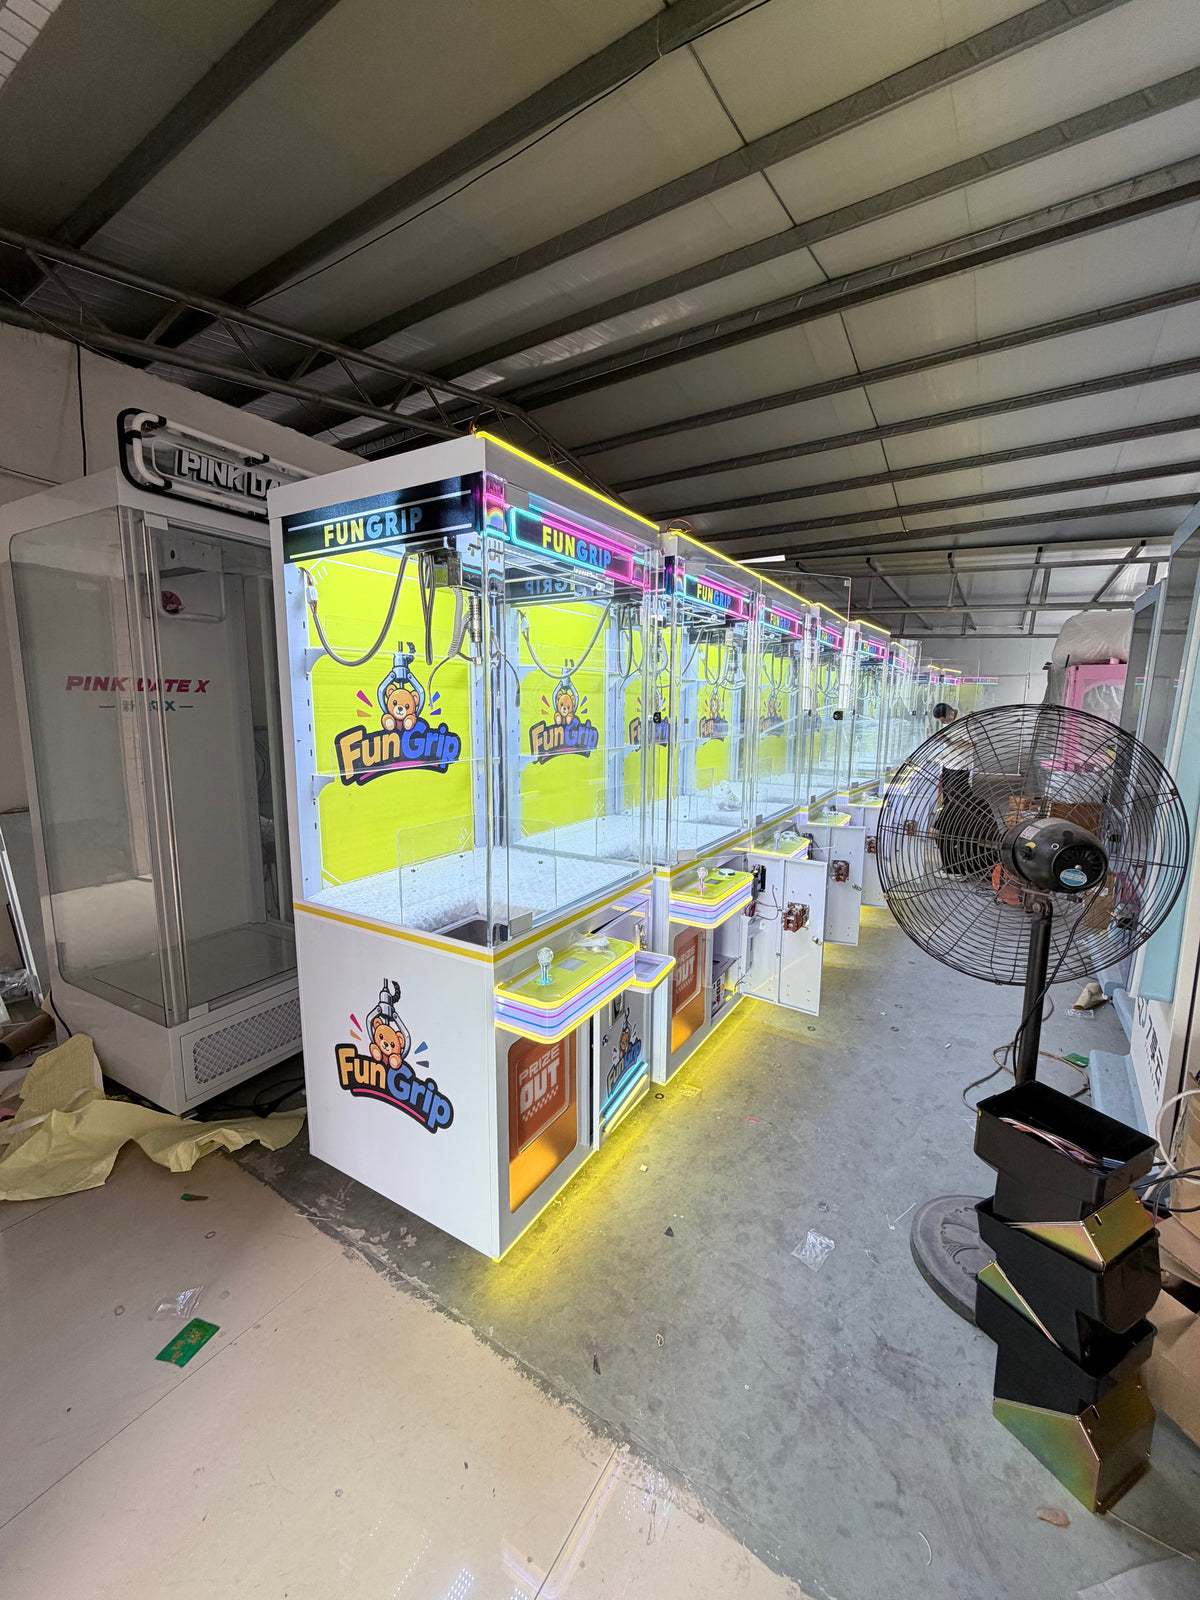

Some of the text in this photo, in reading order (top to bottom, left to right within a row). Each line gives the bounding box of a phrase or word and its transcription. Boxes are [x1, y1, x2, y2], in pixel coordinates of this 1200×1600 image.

[177, 449, 244, 491] PINK
[324, 506, 422, 548] FUNGRIP
[542, 525, 612, 569] FUNGRIP
[696, 583, 732, 609] FUNGRIP
[65, 675, 129, 692] PINK
[194, 679, 210, 693] X
[338, 718, 461, 782] FunGrip
[530, 717, 599, 757] FunGrip
[518, 1043, 560, 1086] PRIZE
[337, 1046, 452, 1130] FunGrip
[519, 1057, 560, 1115] OUT
